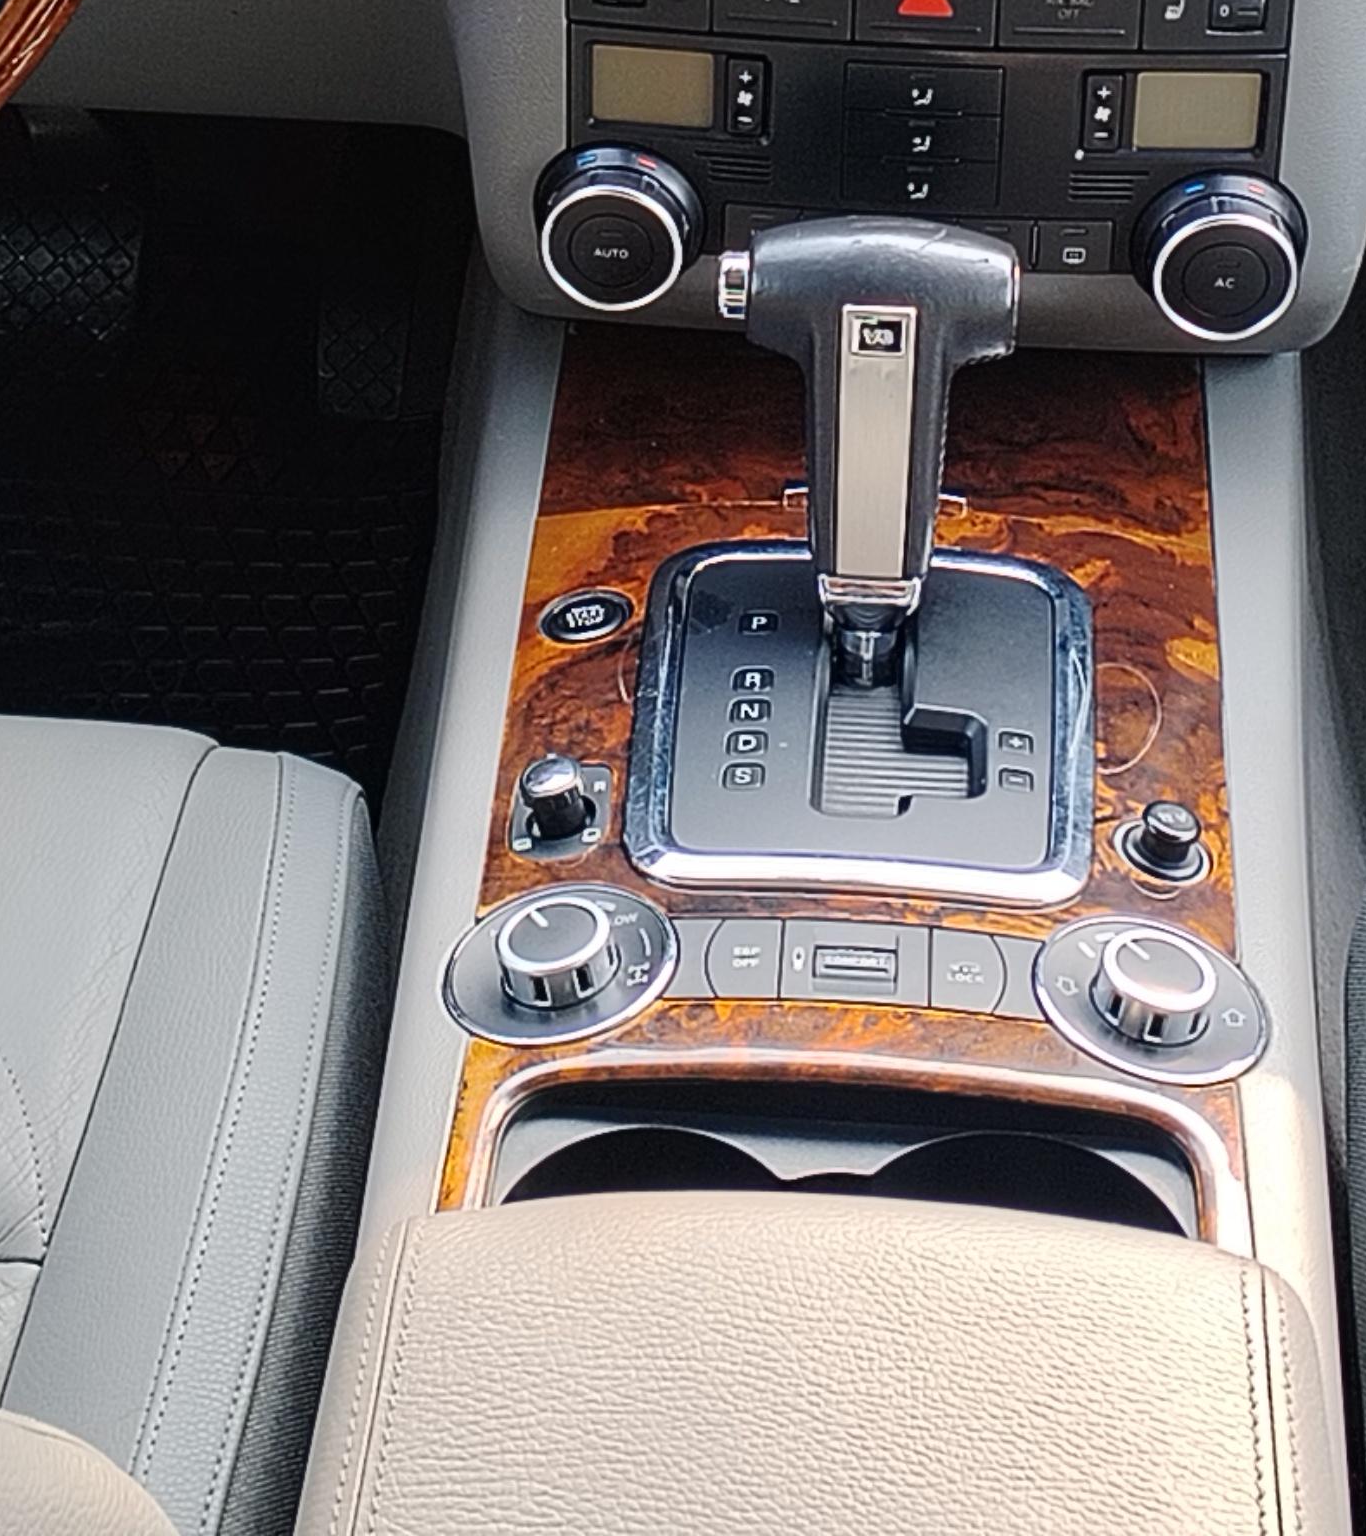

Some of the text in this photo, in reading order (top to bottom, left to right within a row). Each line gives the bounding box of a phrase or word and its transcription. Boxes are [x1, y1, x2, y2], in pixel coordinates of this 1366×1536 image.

[593, 247, 630, 260] AUTO
[1213, 277, 1236, 289] AC
[751, 616, 768, 630] P
[743, 672, 762, 690] R
[740, 703, 760, 719] N
[738, 735, 757, 751] D
[734, 769, 753, 785] S
[947, 972, 985, 985] LOCK
